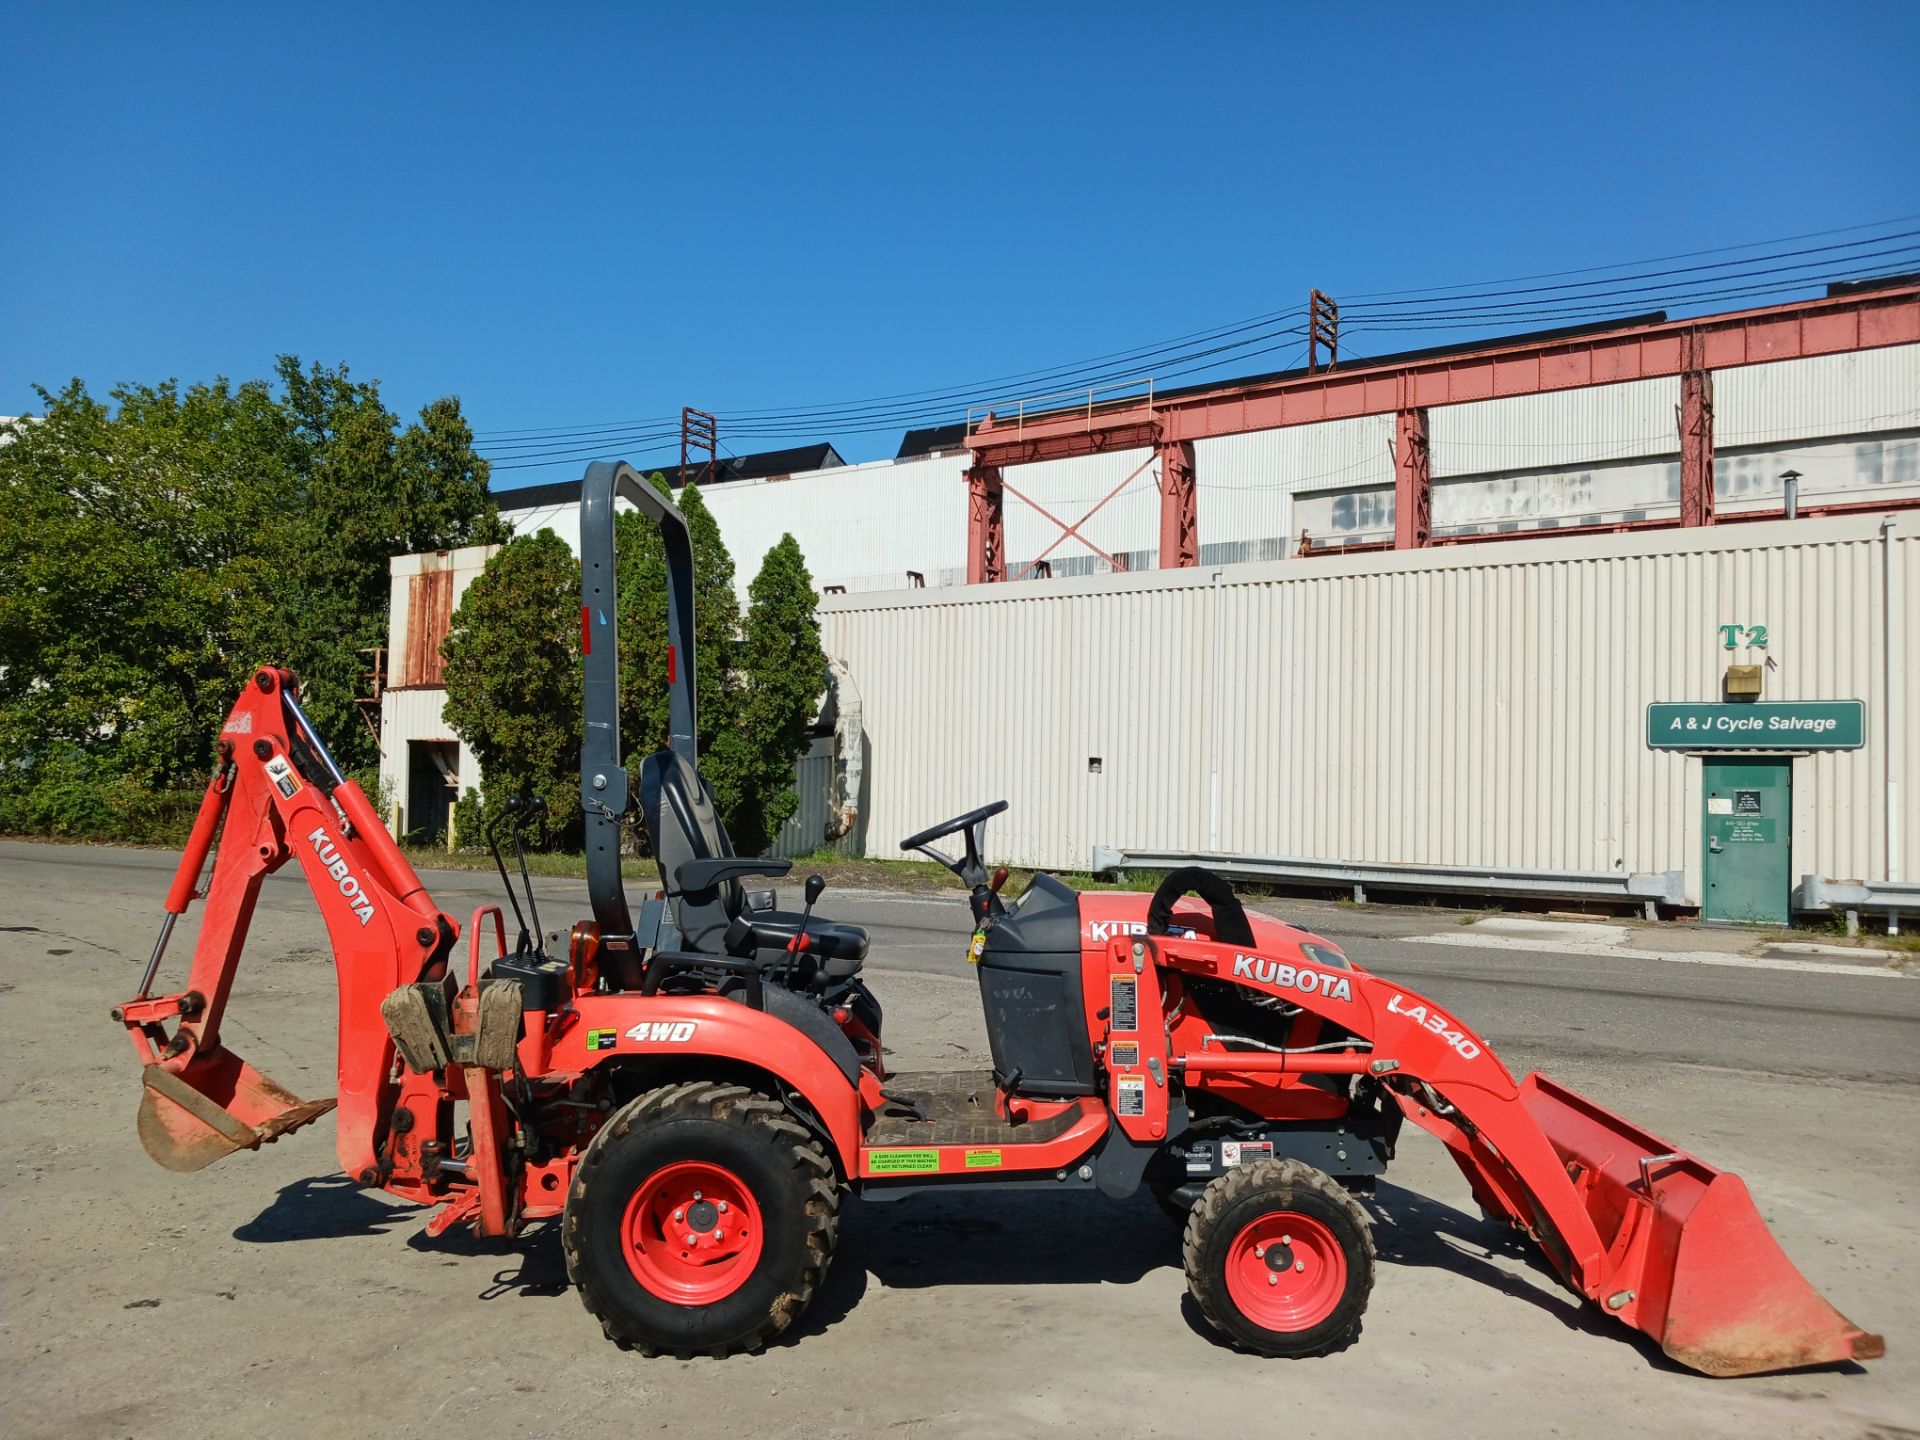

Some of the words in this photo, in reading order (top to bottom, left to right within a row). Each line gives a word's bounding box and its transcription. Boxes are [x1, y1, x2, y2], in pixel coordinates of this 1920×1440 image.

[1720, 624, 1769, 648] T2
[1670, 717, 1682, 730] A
[1686, 717, 1698, 730] &
[1702, 717, 1712, 730] J
[1716, 716, 1764, 733] Cycle
[1768, 716, 1837, 733] Salvage
[307, 827, 375, 928] KUBOTA
[1091, 921, 1198, 942] KUBA
[1233, 954, 1353, 1003] KUBOTA
[624, 1022, 697, 1042] 4WD
[1387, 994, 1481, 1060] LA340
